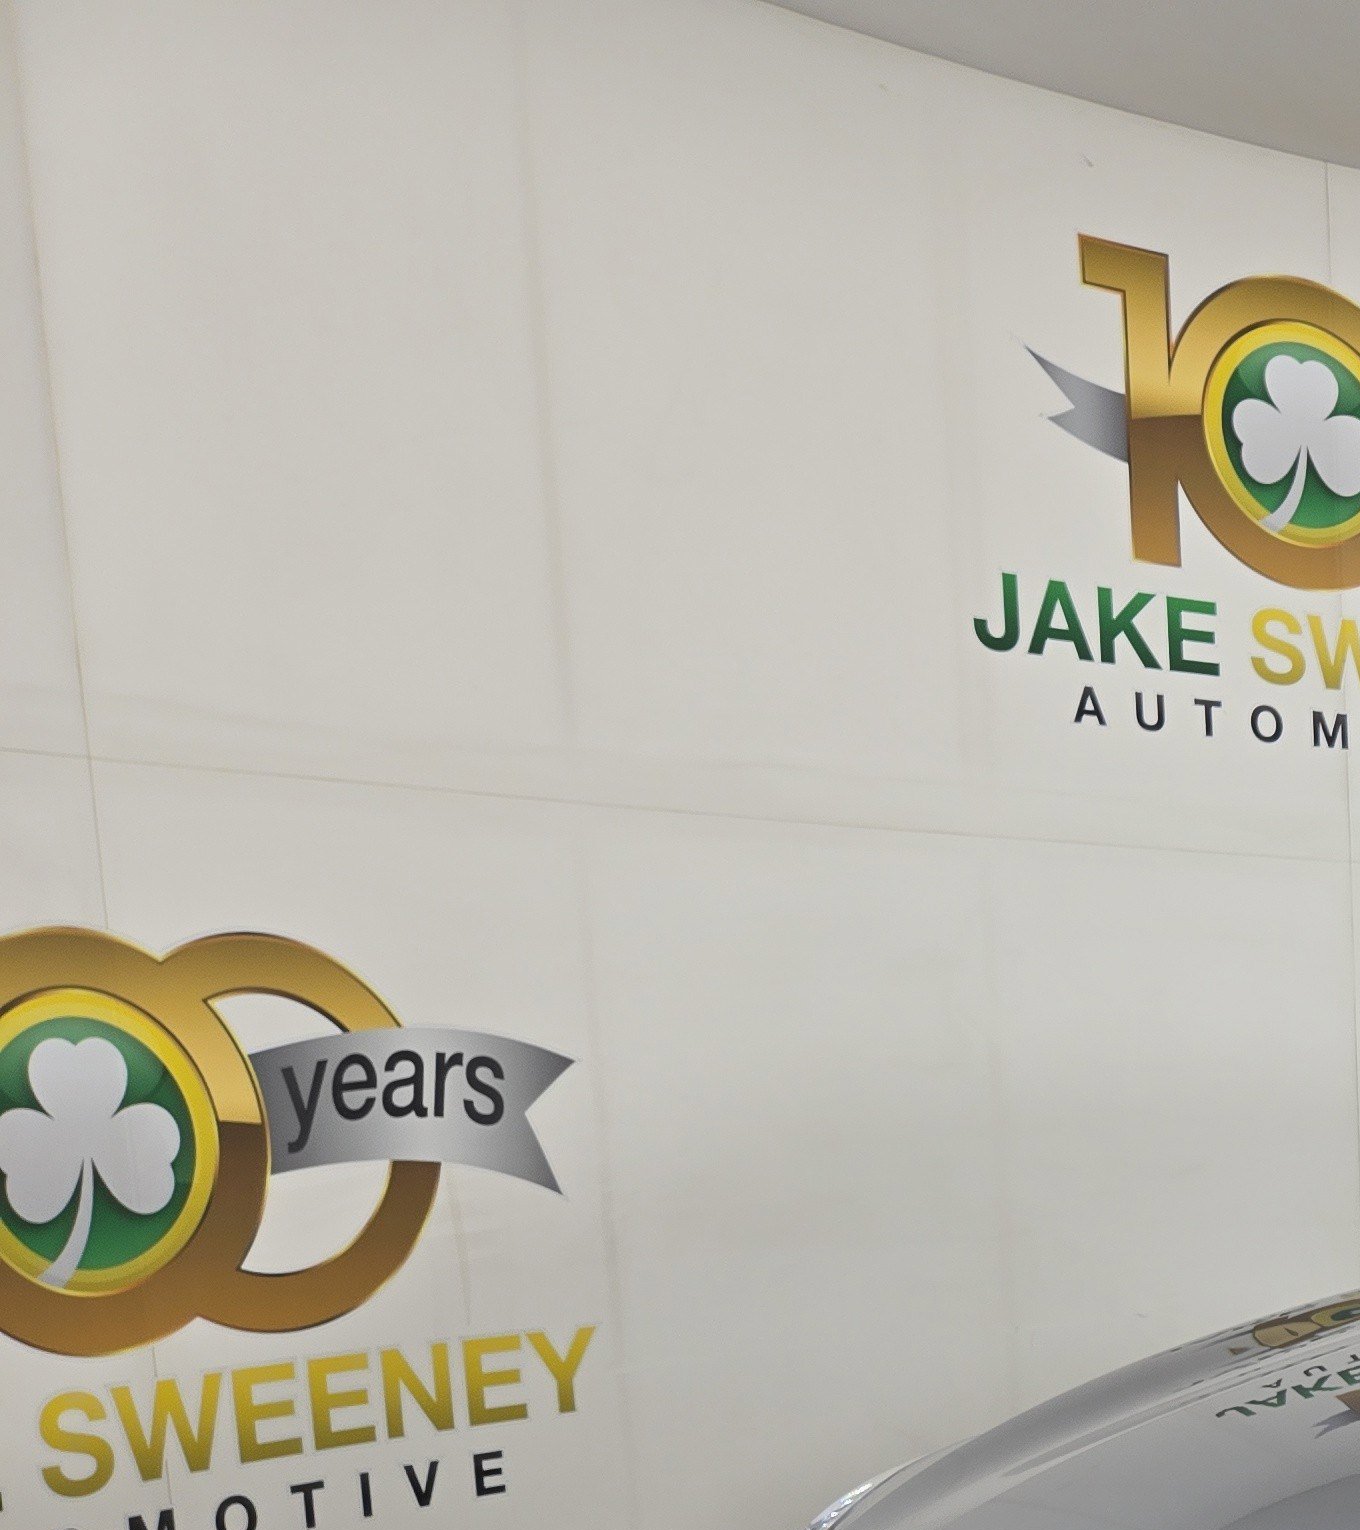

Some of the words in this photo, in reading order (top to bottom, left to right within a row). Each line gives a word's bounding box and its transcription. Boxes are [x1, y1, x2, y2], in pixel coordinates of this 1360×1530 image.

[973, 572, 1222, 677] JAKE
[281, 1049, 506, 1154] years
[38, 1325, 596, 1497] SWEENEY
